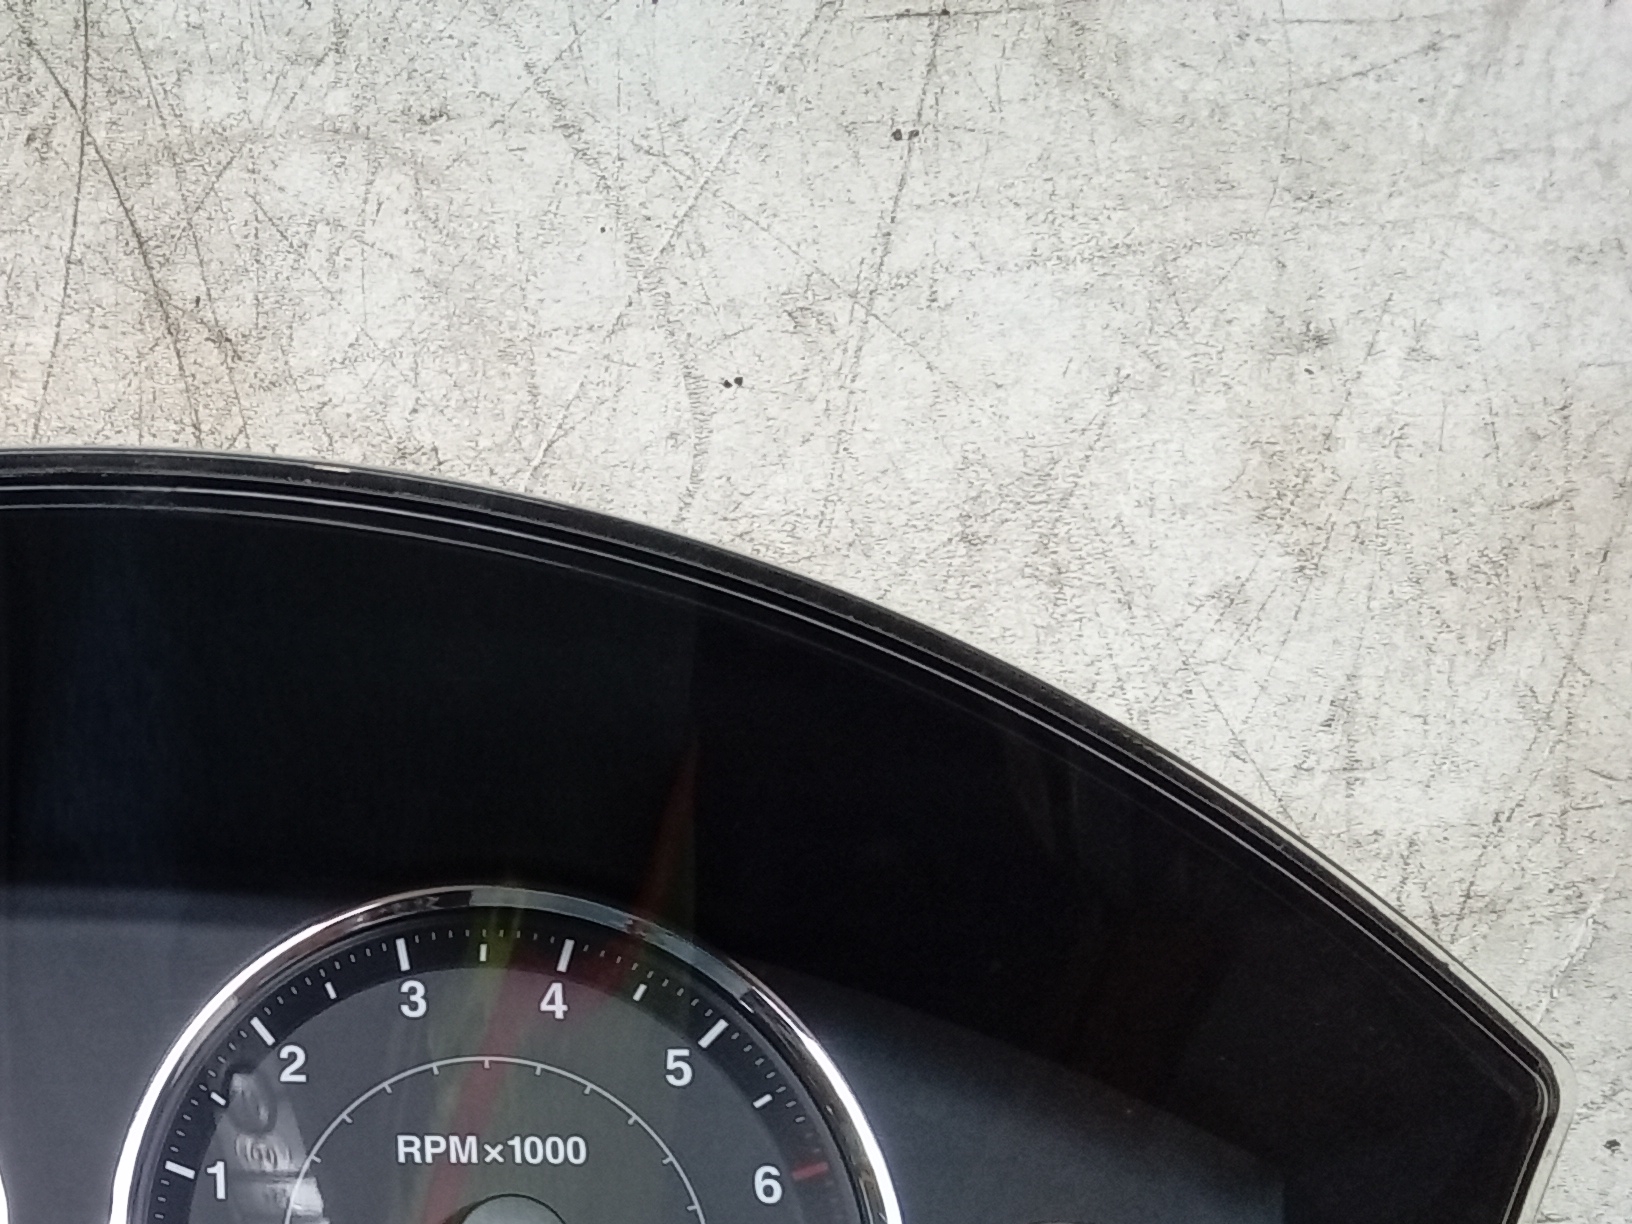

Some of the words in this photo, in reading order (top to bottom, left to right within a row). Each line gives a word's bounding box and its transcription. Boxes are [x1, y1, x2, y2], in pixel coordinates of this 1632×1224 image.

[400, 980, 427, 1018] 3
[540, 982, 568, 1020] 4
[279, 1044, 307, 1083] 2
[665, 1048, 693, 1087] 5
[206, 1160, 226, 1200] 1
[754, 1165, 783, 1204] 6
